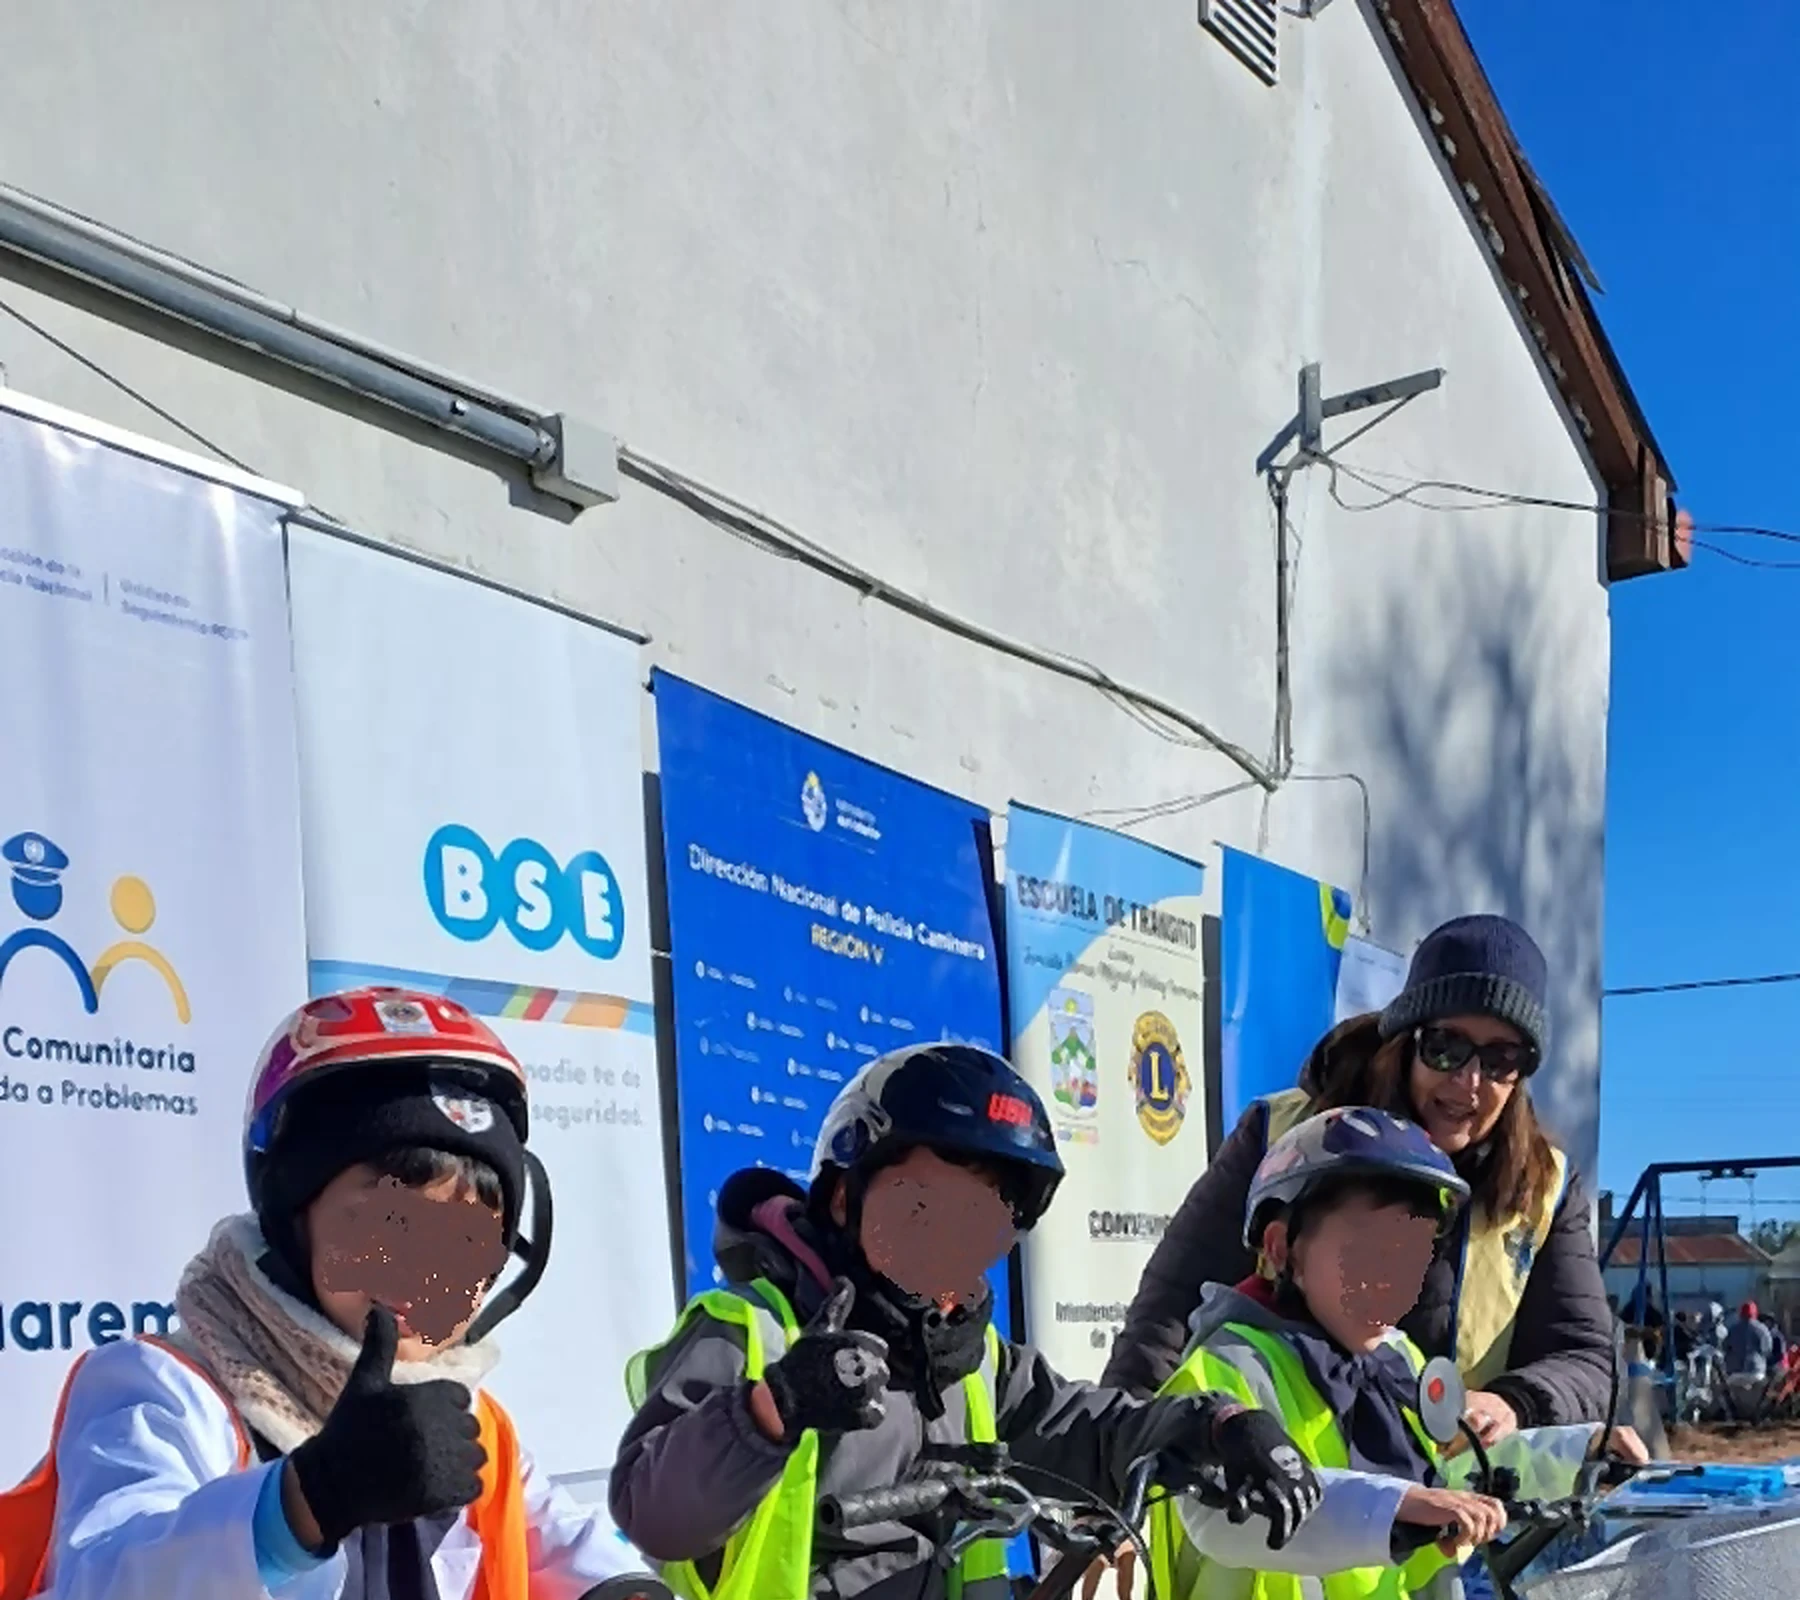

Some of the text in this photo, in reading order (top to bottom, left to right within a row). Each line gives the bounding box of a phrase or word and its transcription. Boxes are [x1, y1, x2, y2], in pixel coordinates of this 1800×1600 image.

[441, 844, 614, 943] BSE
[1017, 874, 1098, 921] ESCUELA
[3, 1026, 195, 1073] Comunitaria
[37, 1085, 53, 1104] a
[62, 1079, 198, 1115] Problemas
